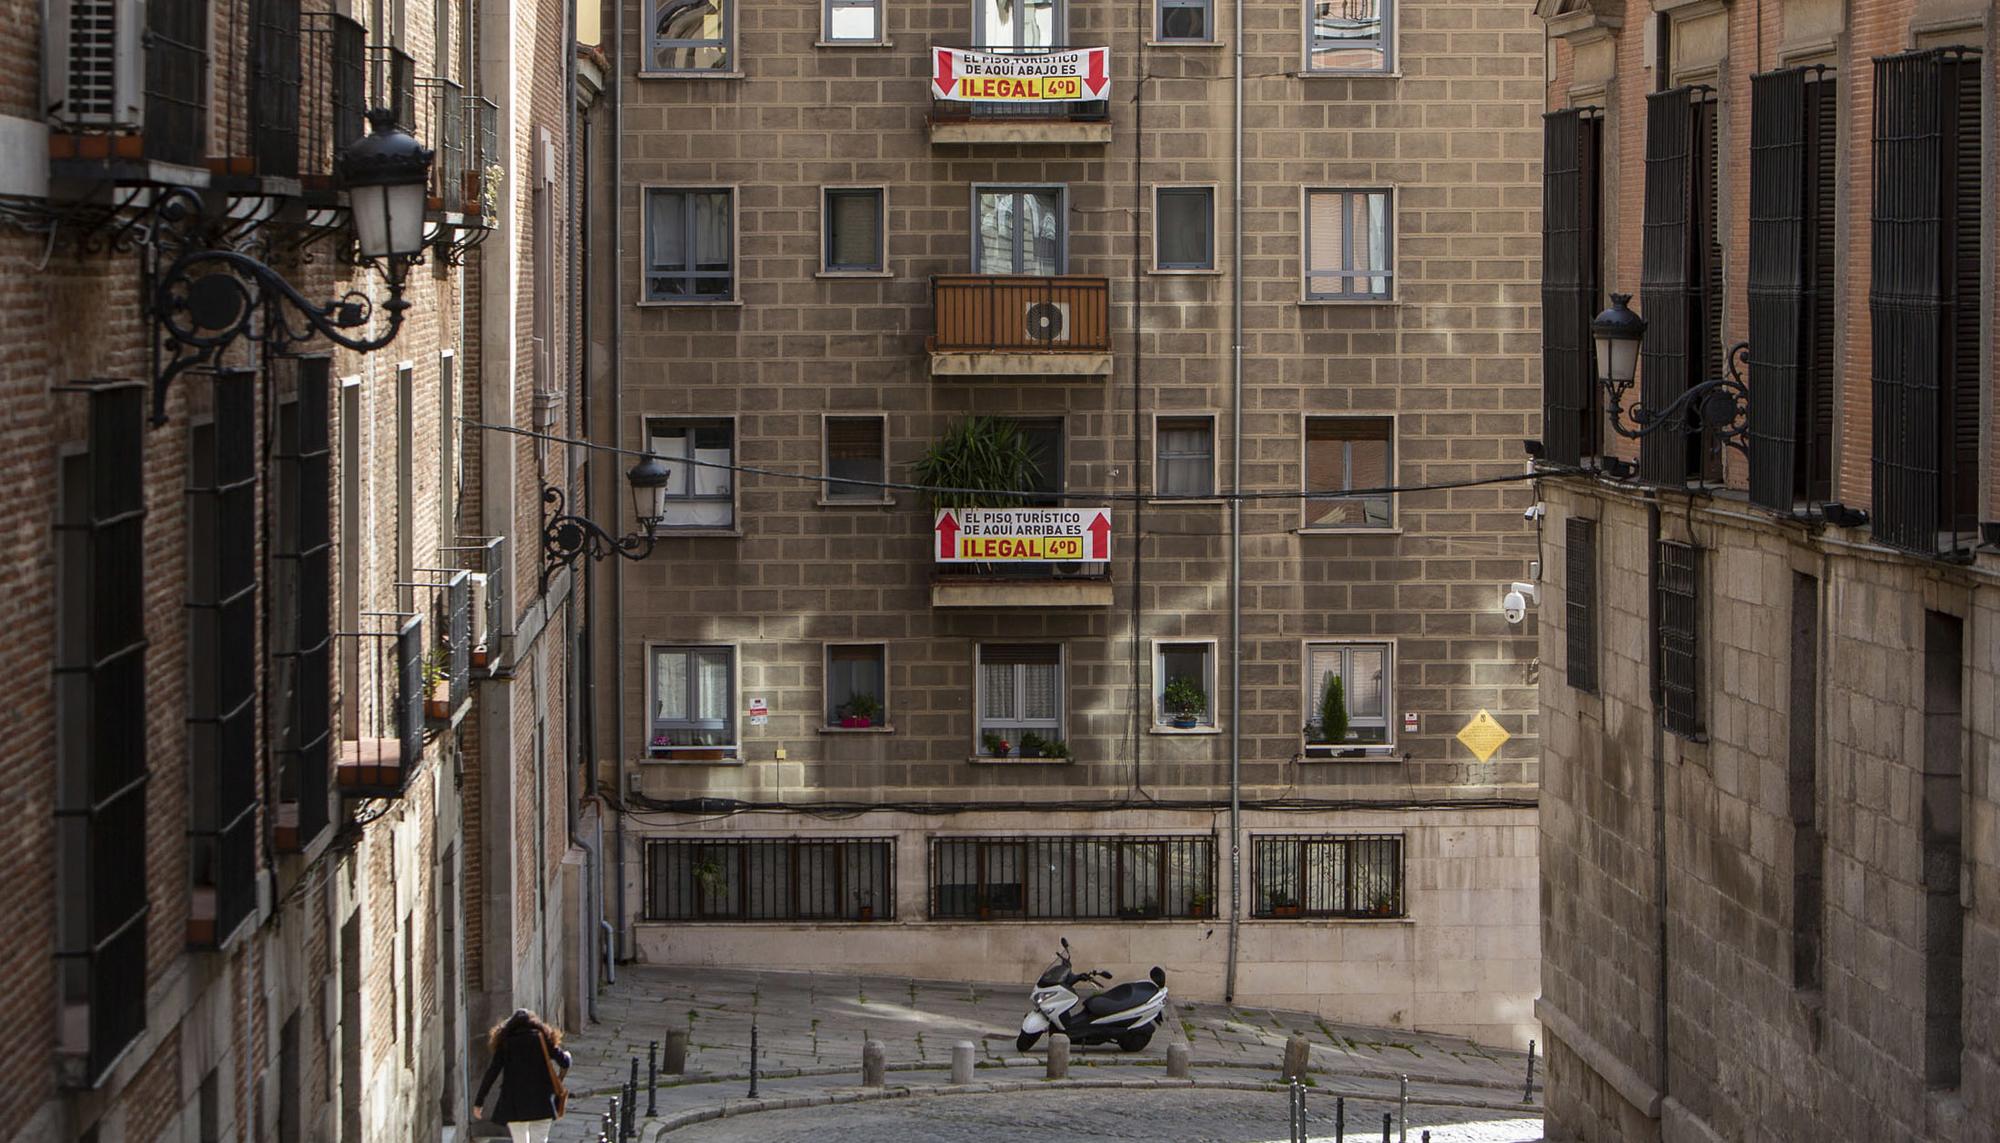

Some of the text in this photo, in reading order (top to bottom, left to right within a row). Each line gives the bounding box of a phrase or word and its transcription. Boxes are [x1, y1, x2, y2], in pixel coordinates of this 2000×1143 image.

[964, 54, 979, 63] EL
[966, 62, 1076, 76] DE AQUÍ ABAJO ES
[962, 79, 1039, 97] ILEGAL
[965, 510, 1080, 523] EL PISO TURÍSTICO
[964, 522, 1081, 535] DE AQUÍ ARRIBA ES
[963, 539, 1041, 557] ILEGAL
